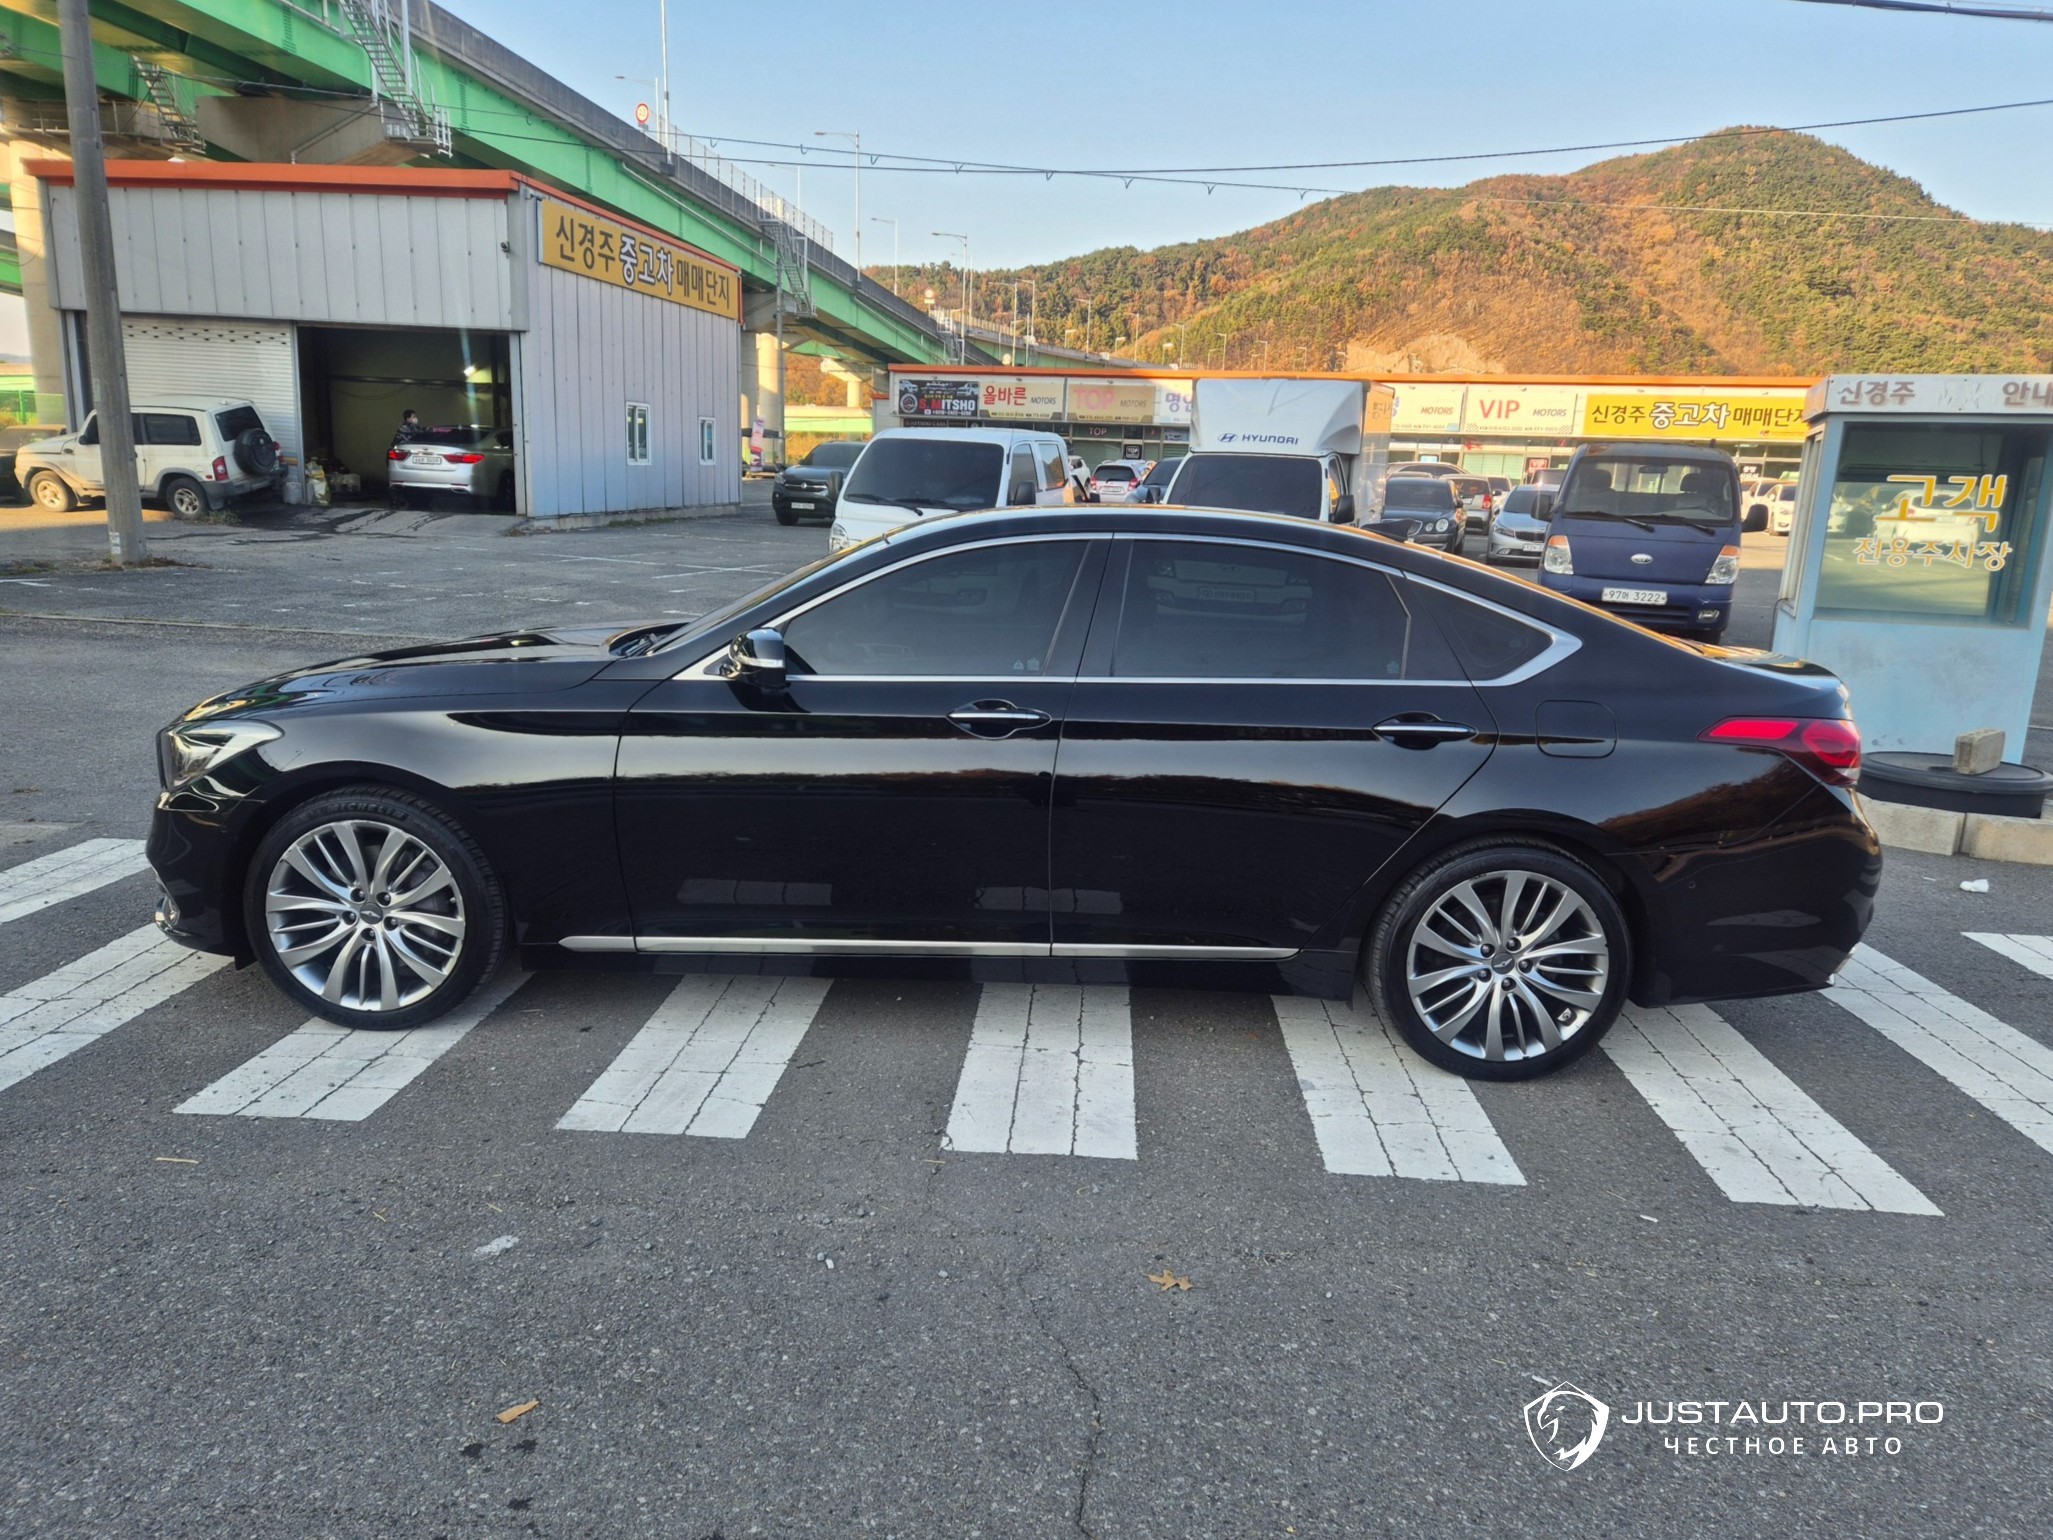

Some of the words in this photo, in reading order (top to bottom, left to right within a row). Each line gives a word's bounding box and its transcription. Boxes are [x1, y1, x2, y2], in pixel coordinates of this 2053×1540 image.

[556, 215, 616, 272] 신경주
[618, 233, 674, 296] 중고차
[676, 258, 730, 310] 매매단지
[983, 385, 1027, 406] 올바른
[1030, 396, 1057, 405] MOTORS
[1073, 387, 1117, 411] TOP
[1120, 399, 1147, 408] MOTORS
[1838, 380, 1916, 406] 신경주
[1420, 406, 1454, 415] MOTORS
[1479, 399, 1521, 419] VIP
[1532, 408, 1568, 417] MOTORS
[1591, 405, 1646, 425] 신경주
[1650, 401, 1731, 430] 중고차
[1089, 427, 1107, 436] TOP
[1242, 434, 1298, 445] HYUNDAI
[1873, 474, 2008, 533] 고객
[1852, 537, 2013, 572] 전용주차장
[1633, 592, 1661, 603] 3222
